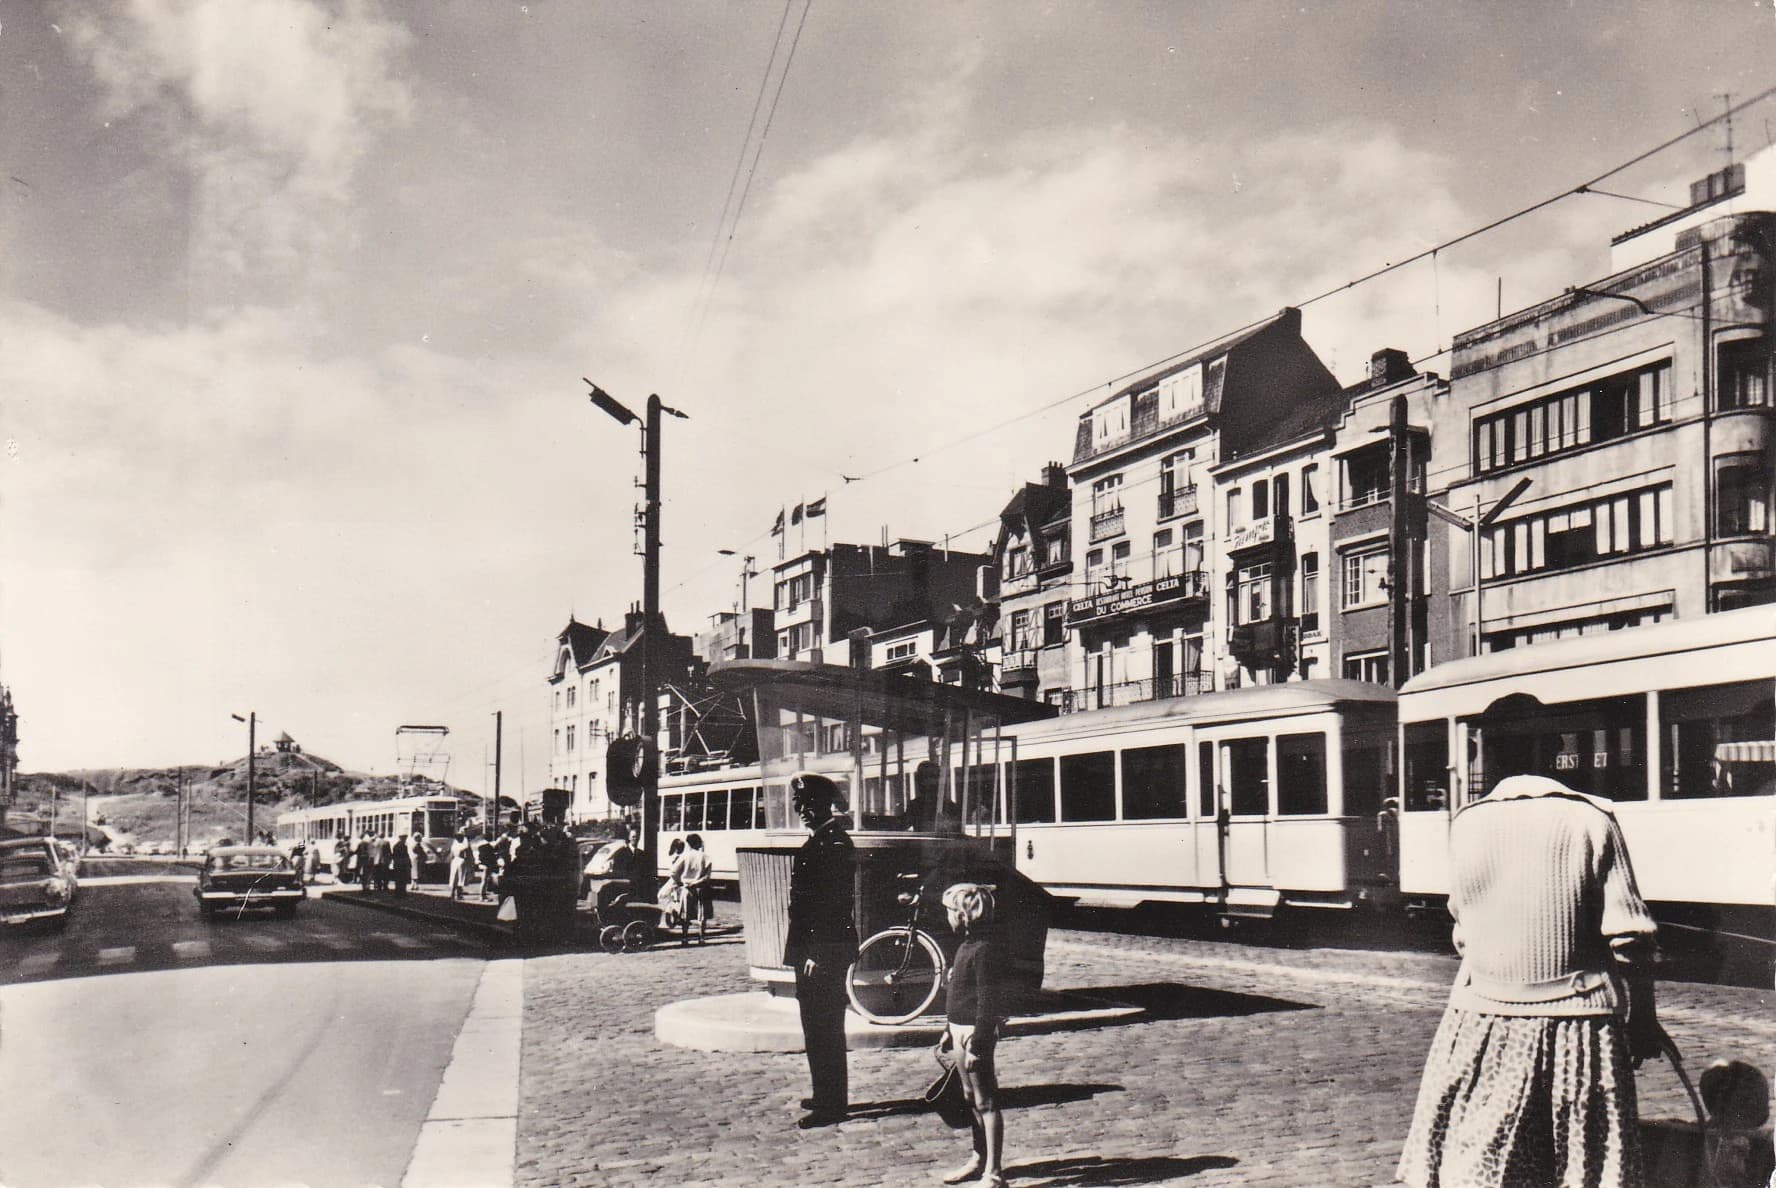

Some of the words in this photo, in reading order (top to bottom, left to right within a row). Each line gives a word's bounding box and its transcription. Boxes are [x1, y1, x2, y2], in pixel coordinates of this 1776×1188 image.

[1073, 600, 1093, 612] CELTA
[1157, 579, 1180, 592] CELTA
[1096, 606, 1107, 616] DU
[1110, 595, 1152, 612] COMMERCE
